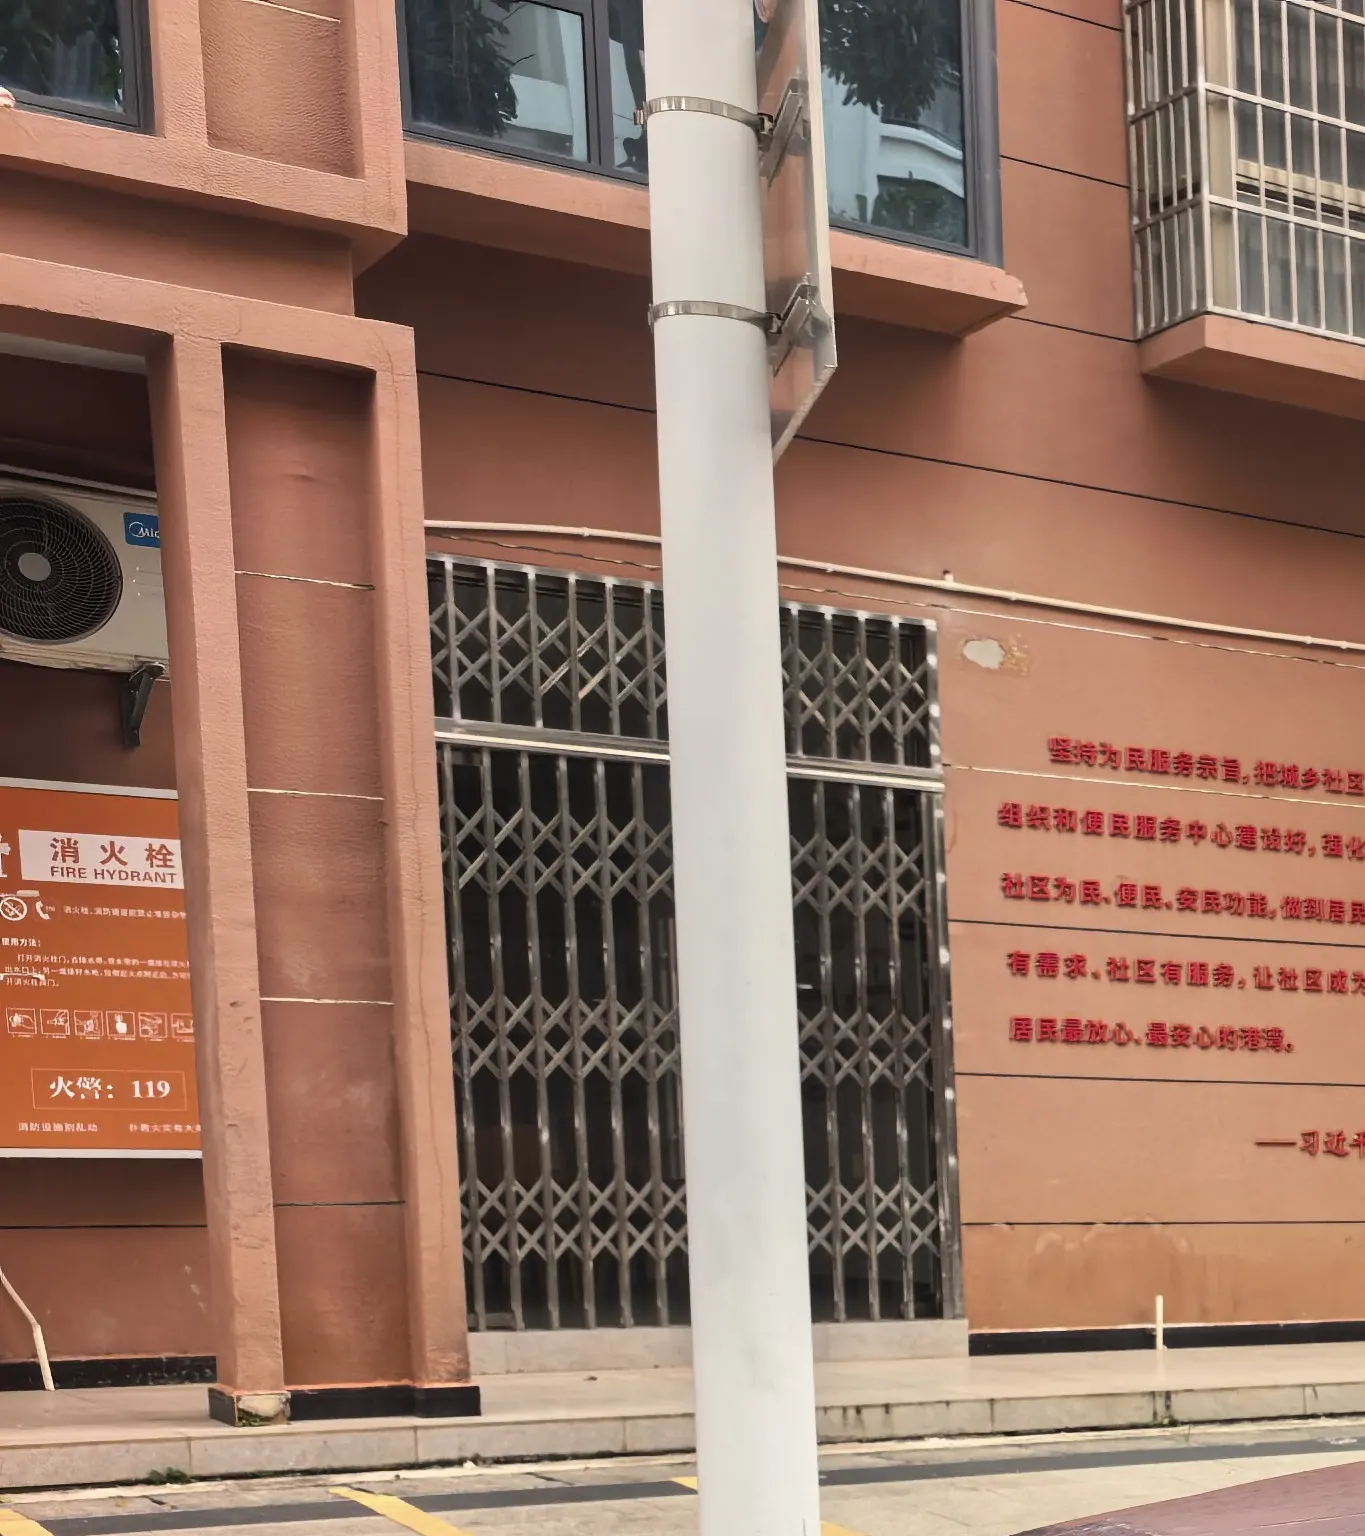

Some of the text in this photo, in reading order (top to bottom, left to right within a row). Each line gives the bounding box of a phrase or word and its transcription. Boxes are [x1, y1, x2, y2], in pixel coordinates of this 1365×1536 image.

[50, 838, 175, 869] 消火栓
[50, 866, 178, 885] FIRE HYDRANT
[132, 1080, 171, 1099] 119
